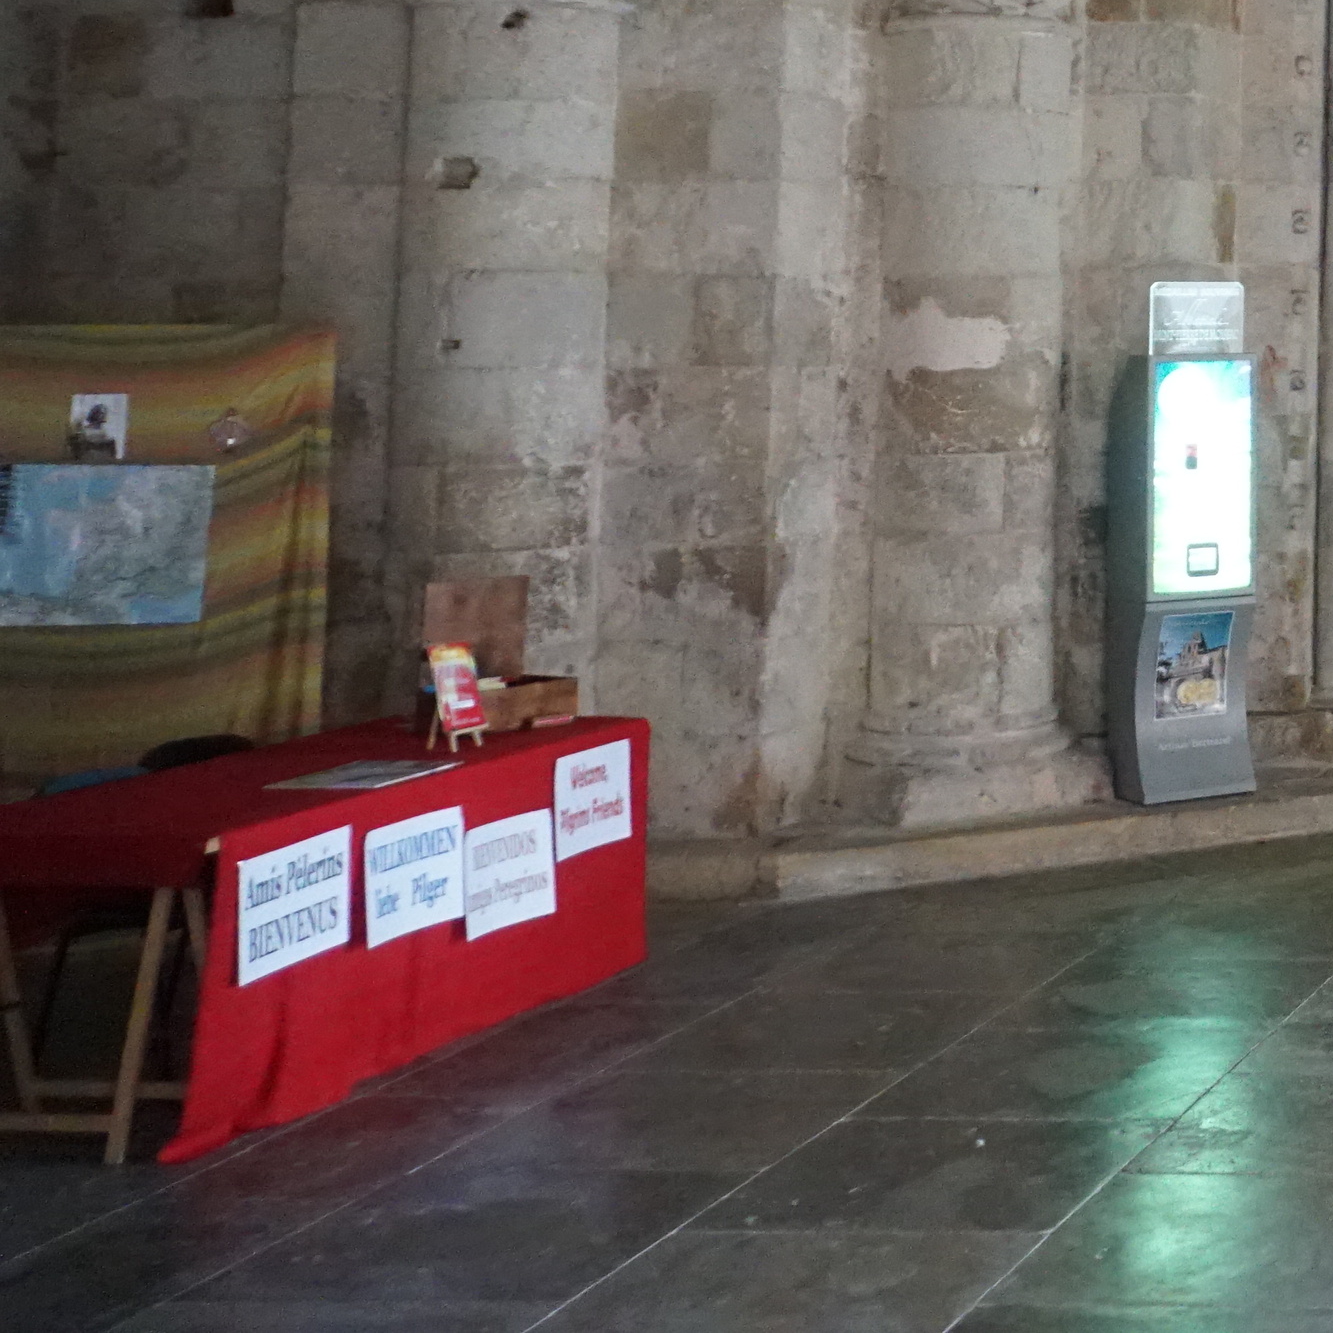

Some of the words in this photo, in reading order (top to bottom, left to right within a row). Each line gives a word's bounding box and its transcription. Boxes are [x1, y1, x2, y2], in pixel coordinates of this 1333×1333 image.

[367, 824, 459, 874] WILLKOMMEN
[244, 865, 283, 910] Amis
[411, 872, 449, 908] Pilger
[248, 896, 339, 964] BIENVENUS
